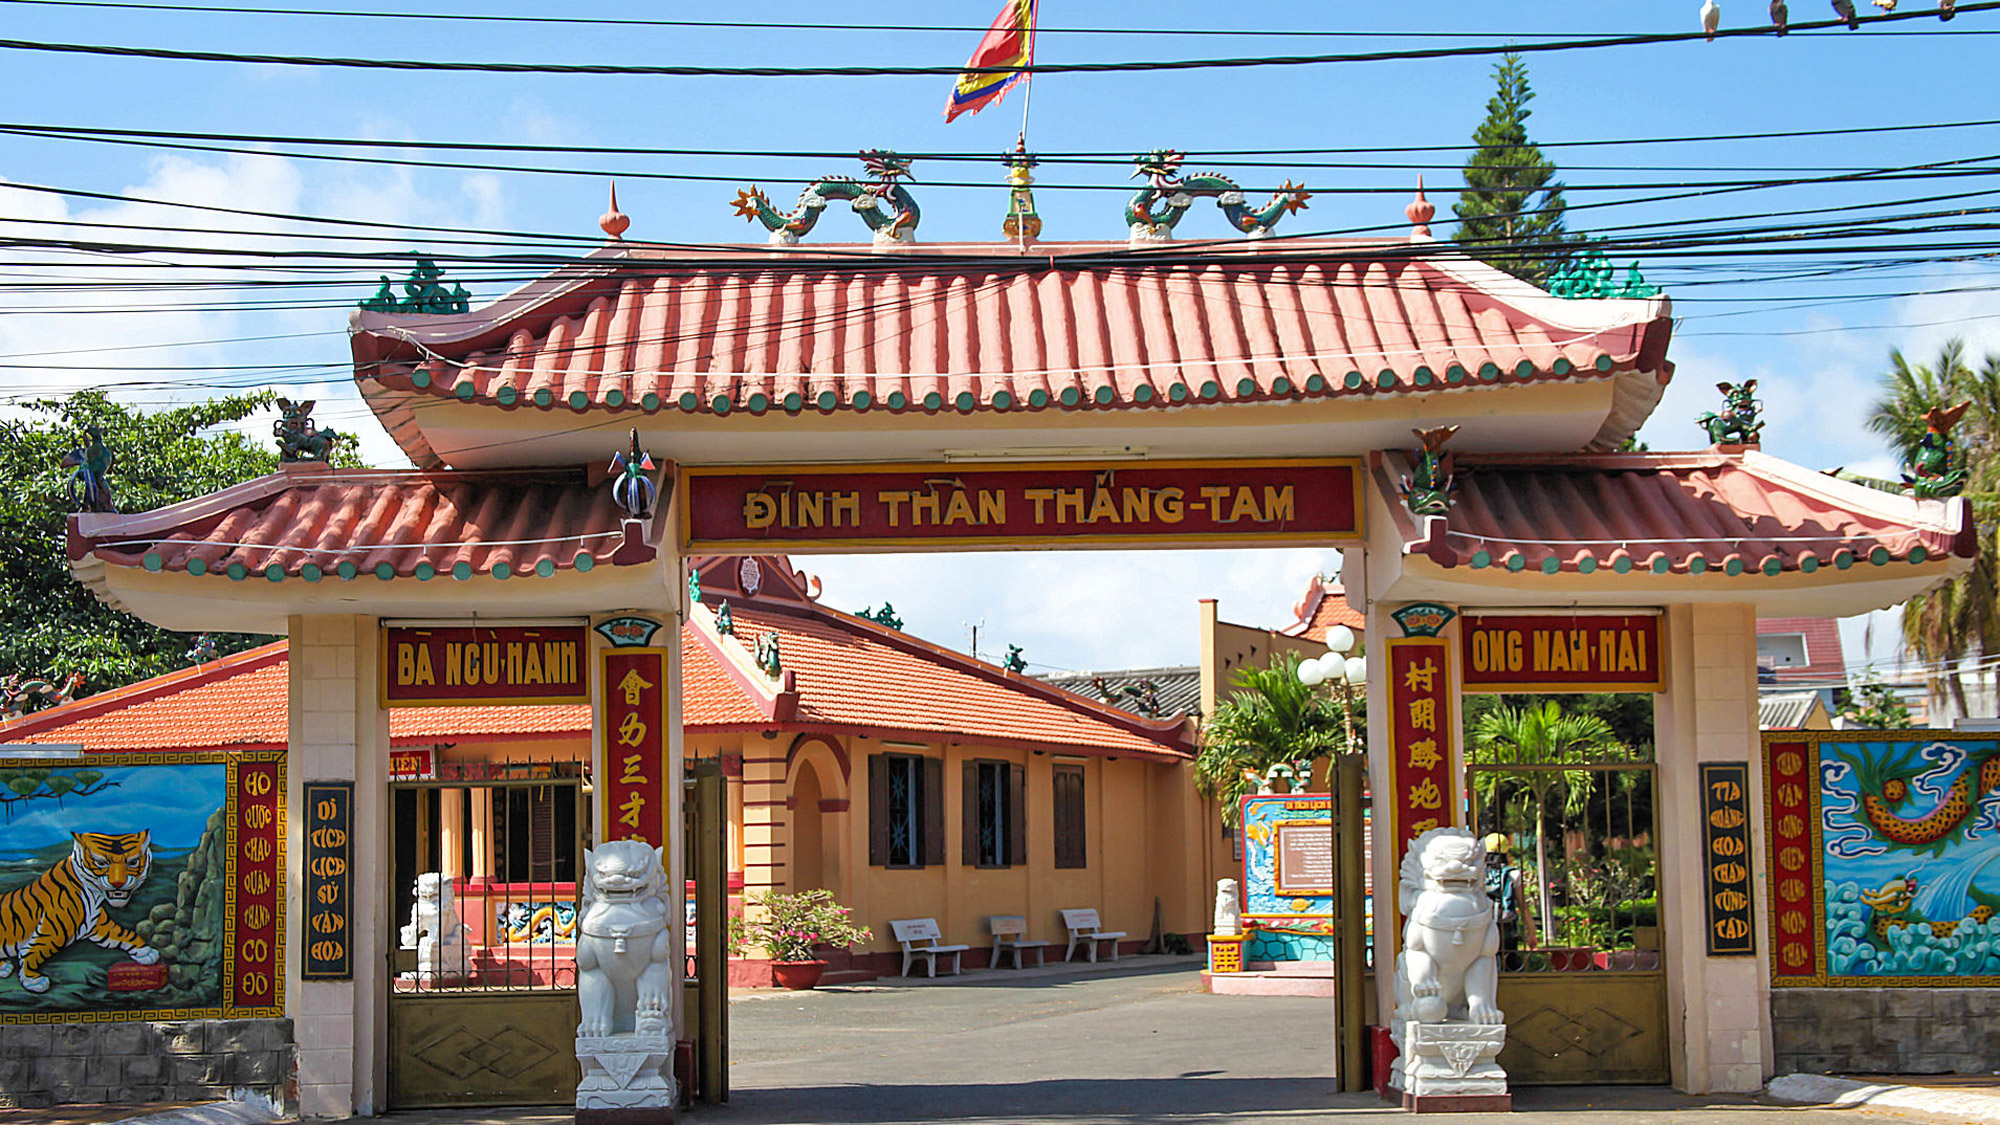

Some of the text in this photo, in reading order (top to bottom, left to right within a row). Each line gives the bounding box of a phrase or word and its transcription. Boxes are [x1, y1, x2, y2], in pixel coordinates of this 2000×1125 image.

[311, 825, 346, 848] TÍCH
[1712, 836, 1744, 856] HOA
[311, 856, 346, 880] LỊCH
